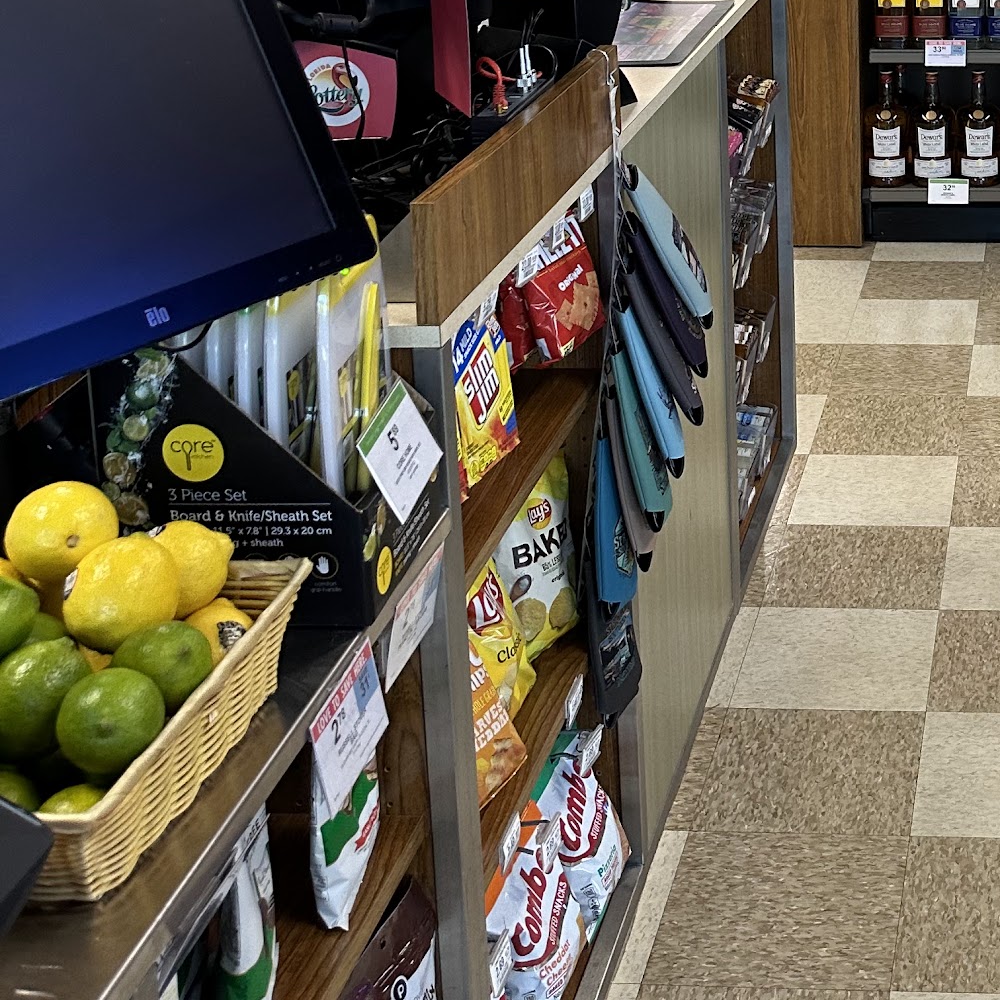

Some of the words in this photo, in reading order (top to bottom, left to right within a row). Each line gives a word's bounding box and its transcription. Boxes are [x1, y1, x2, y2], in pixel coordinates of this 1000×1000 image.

[308, 63, 331, 82] LORIDA
[170, 439, 214, 453] core
[168, 488, 177, 501] 3
[182, 488, 220, 501] Piece
[224, 489, 247, 501] Set
[170, 510, 211, 522] Board
[215, 510, 224, 522] &
[228, 510, 309, 522] Knife/Sheath
[312, 510, 333, 522] Set
[527, 499, 551, 526] Lay's
[271, 527, 291, 535] 29.3
[301, 527, 313, 535] 20
[251, 538, 284, 547] sheath
[316, 709, 331, 734] LOVE
[340, 674, 353, 698] SAVE
[539, 939, 571, 978] Cheddar
